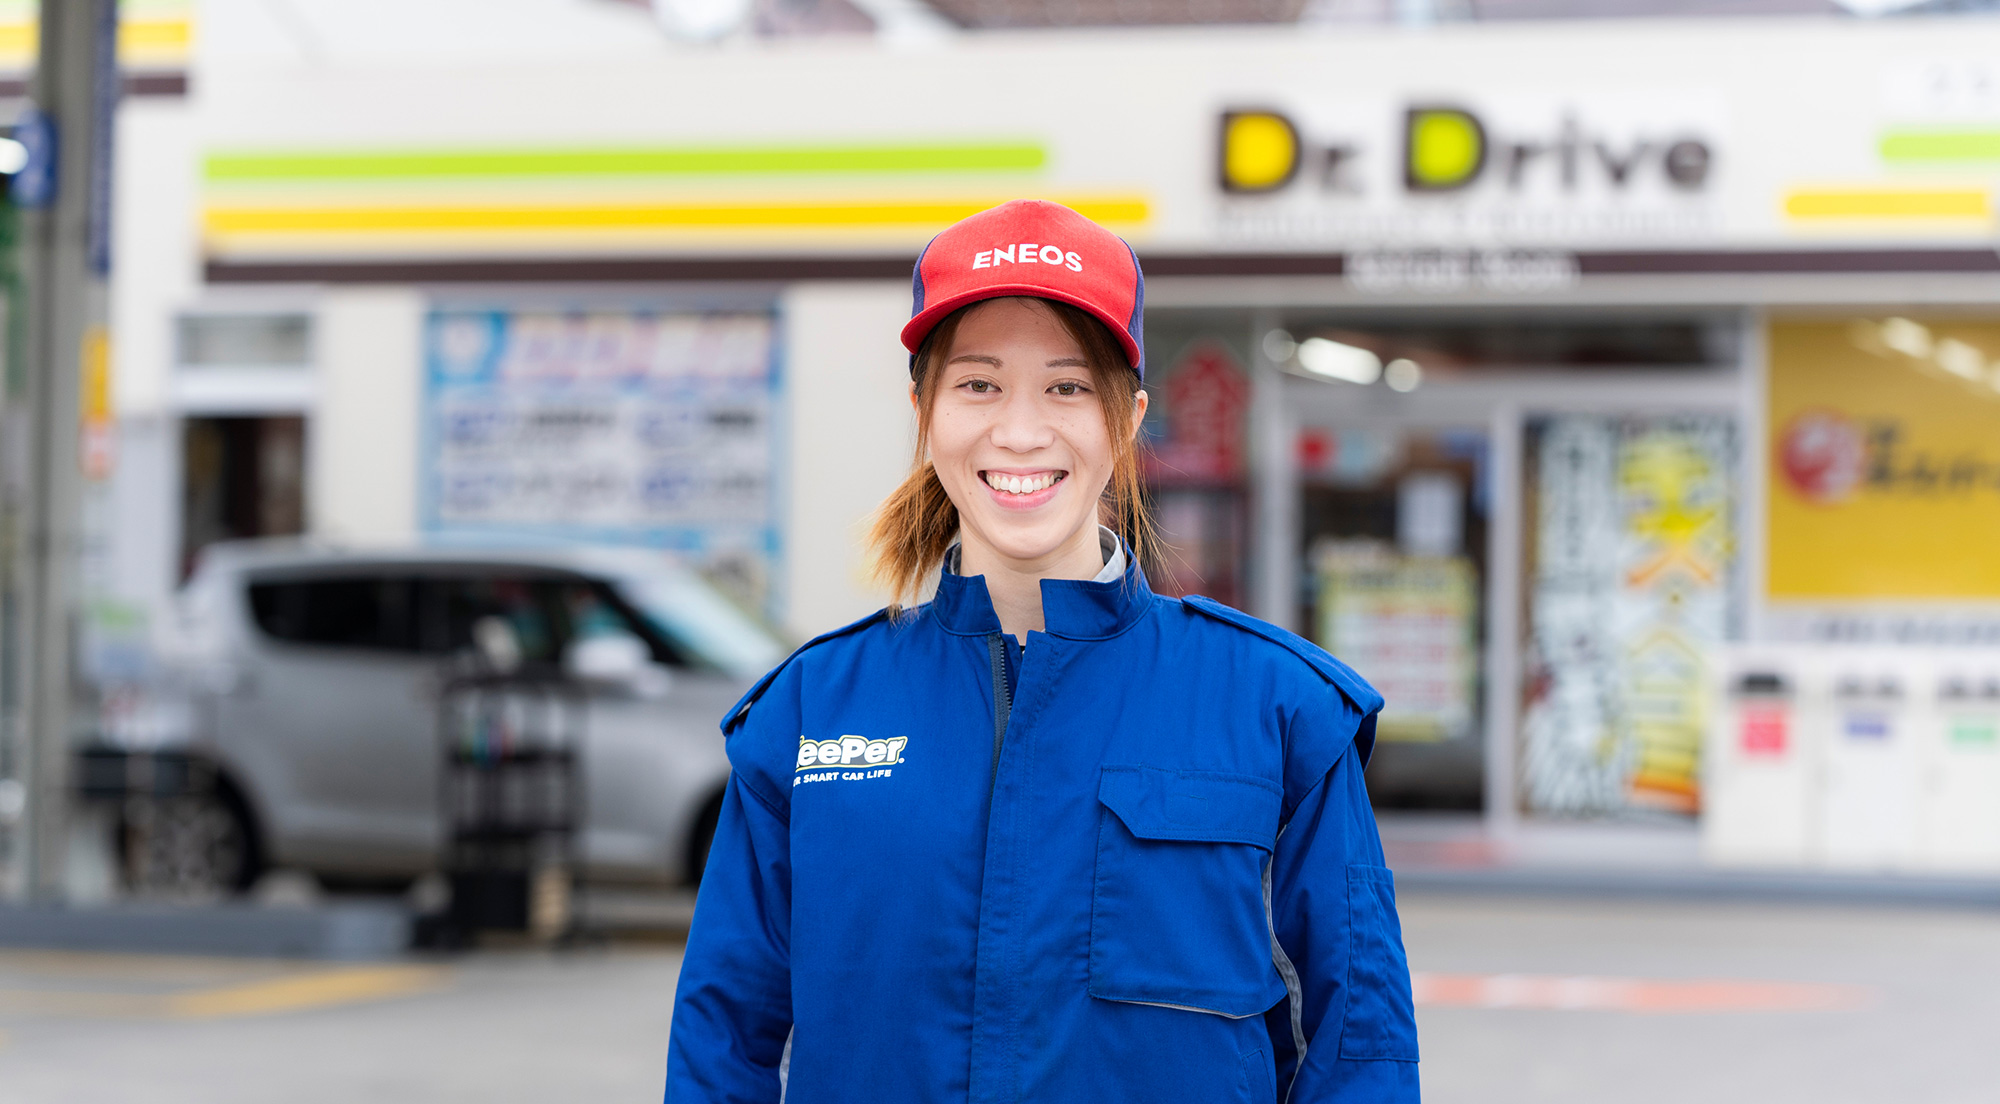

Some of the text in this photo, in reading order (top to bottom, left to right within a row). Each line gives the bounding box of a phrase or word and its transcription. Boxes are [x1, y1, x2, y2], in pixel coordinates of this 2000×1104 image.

[1402, 106, 1714, 195] Drive
[972, 243, 1083, 272] ENEOS
[803, 772, 839, 783] SMART
[842, 772, 864, 781] CAR
[867, 769, 892, 778] LIFE
